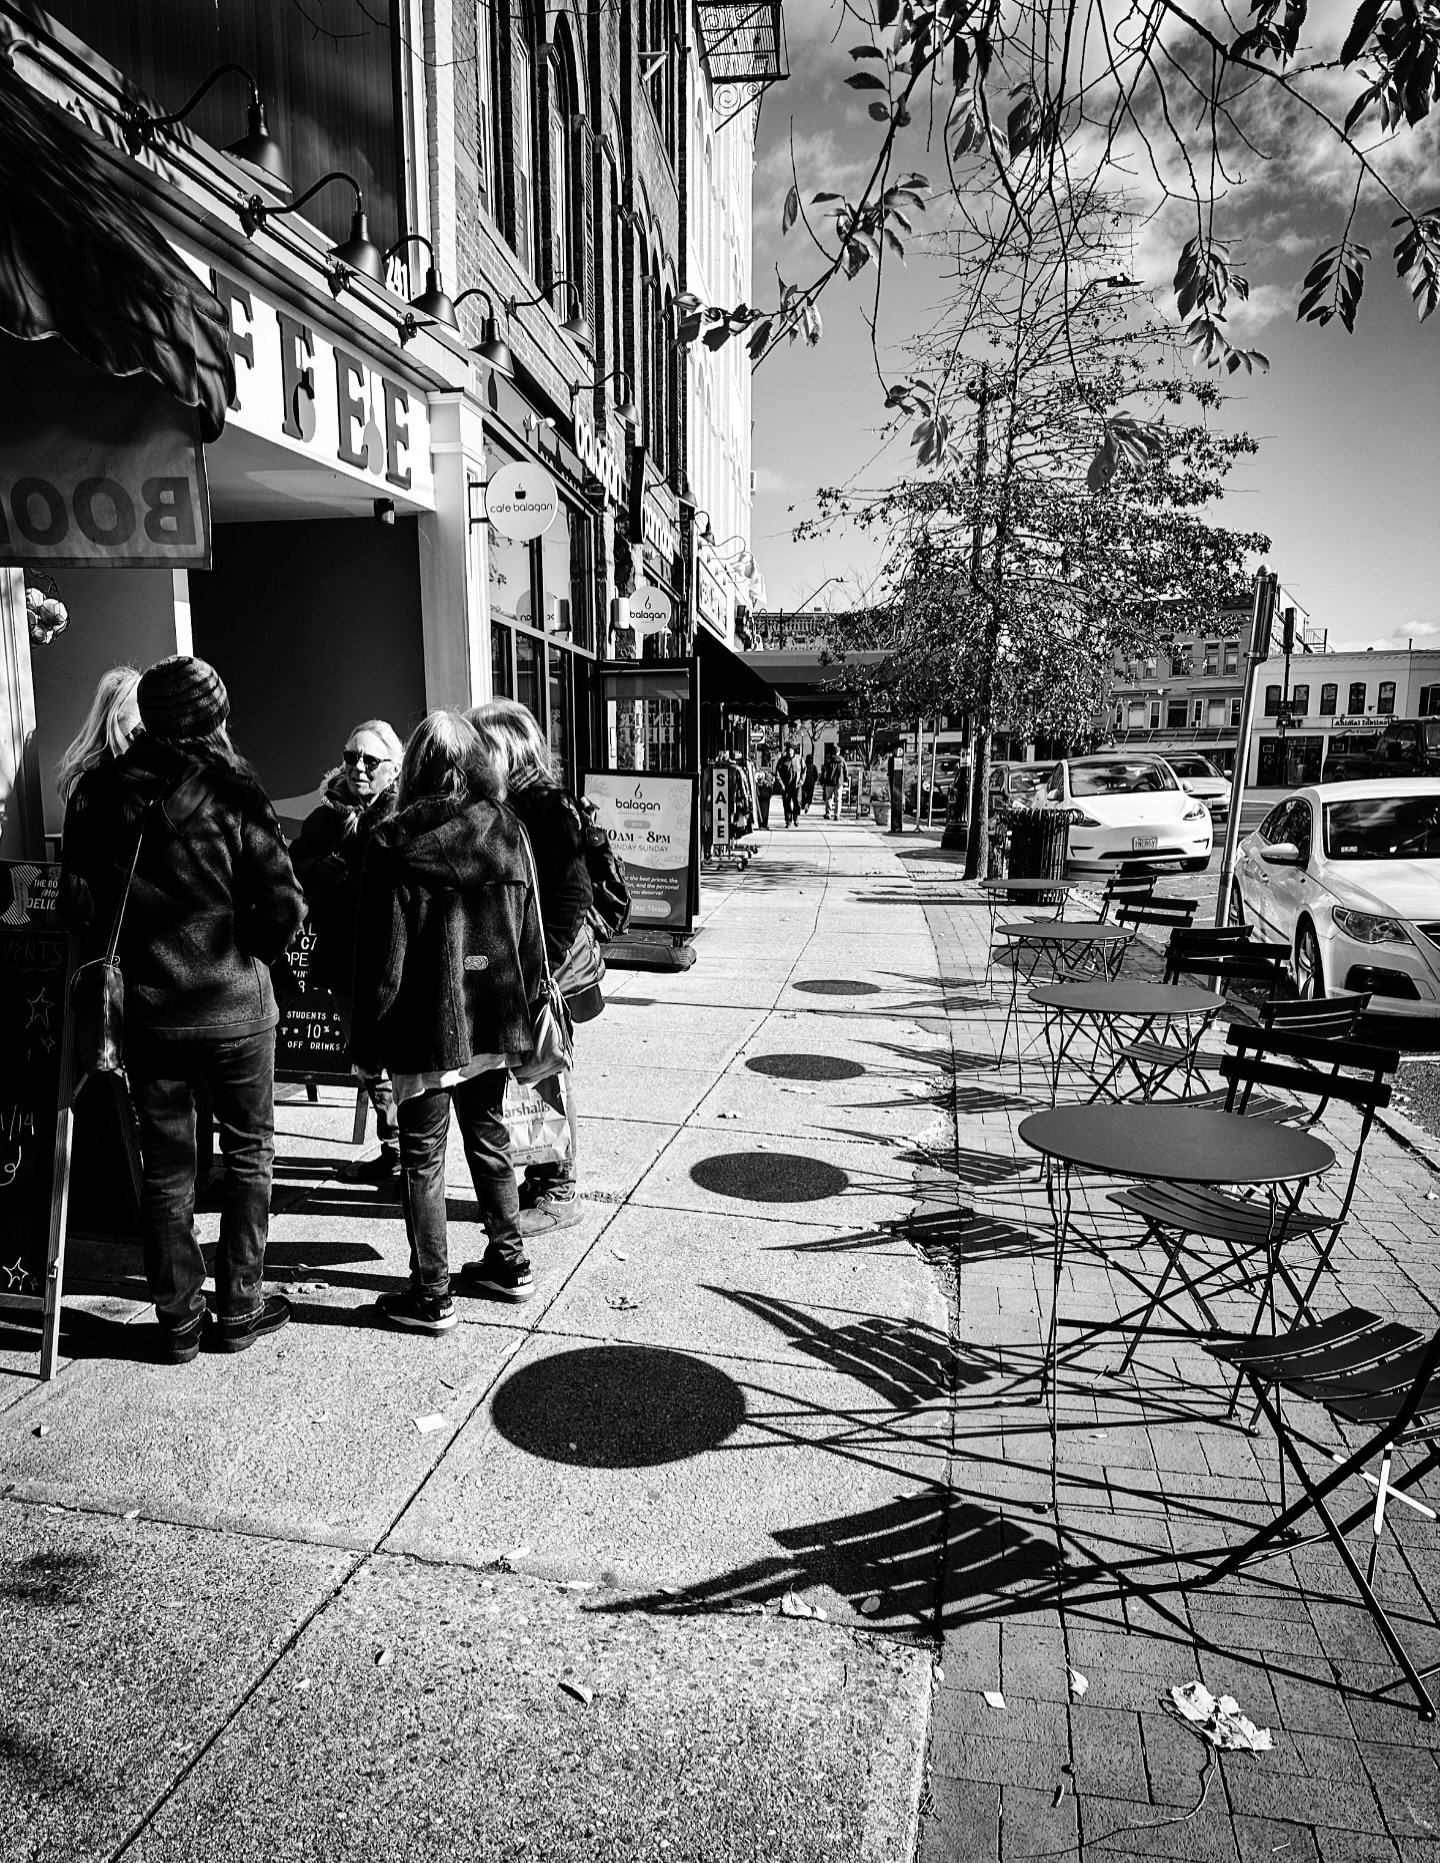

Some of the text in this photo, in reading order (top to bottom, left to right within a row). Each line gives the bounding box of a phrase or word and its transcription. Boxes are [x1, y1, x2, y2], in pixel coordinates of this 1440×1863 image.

[490, 502, 553, 513] cafe balagan
[629, 610, 667, 622] balagan
[615, 798, 661, 813] balagan
[714, 773, 726, 838] SALE
[646, 831, 671, 844] 8PM
[638, 844, 669, 853] SUNDAY
[33, 879, 46, 887] THE
[648, 904, 668, 913] Menu
[286, 1010, 327, 1021] STUDENTS
[287, 1040, 304, 1049] OFF
